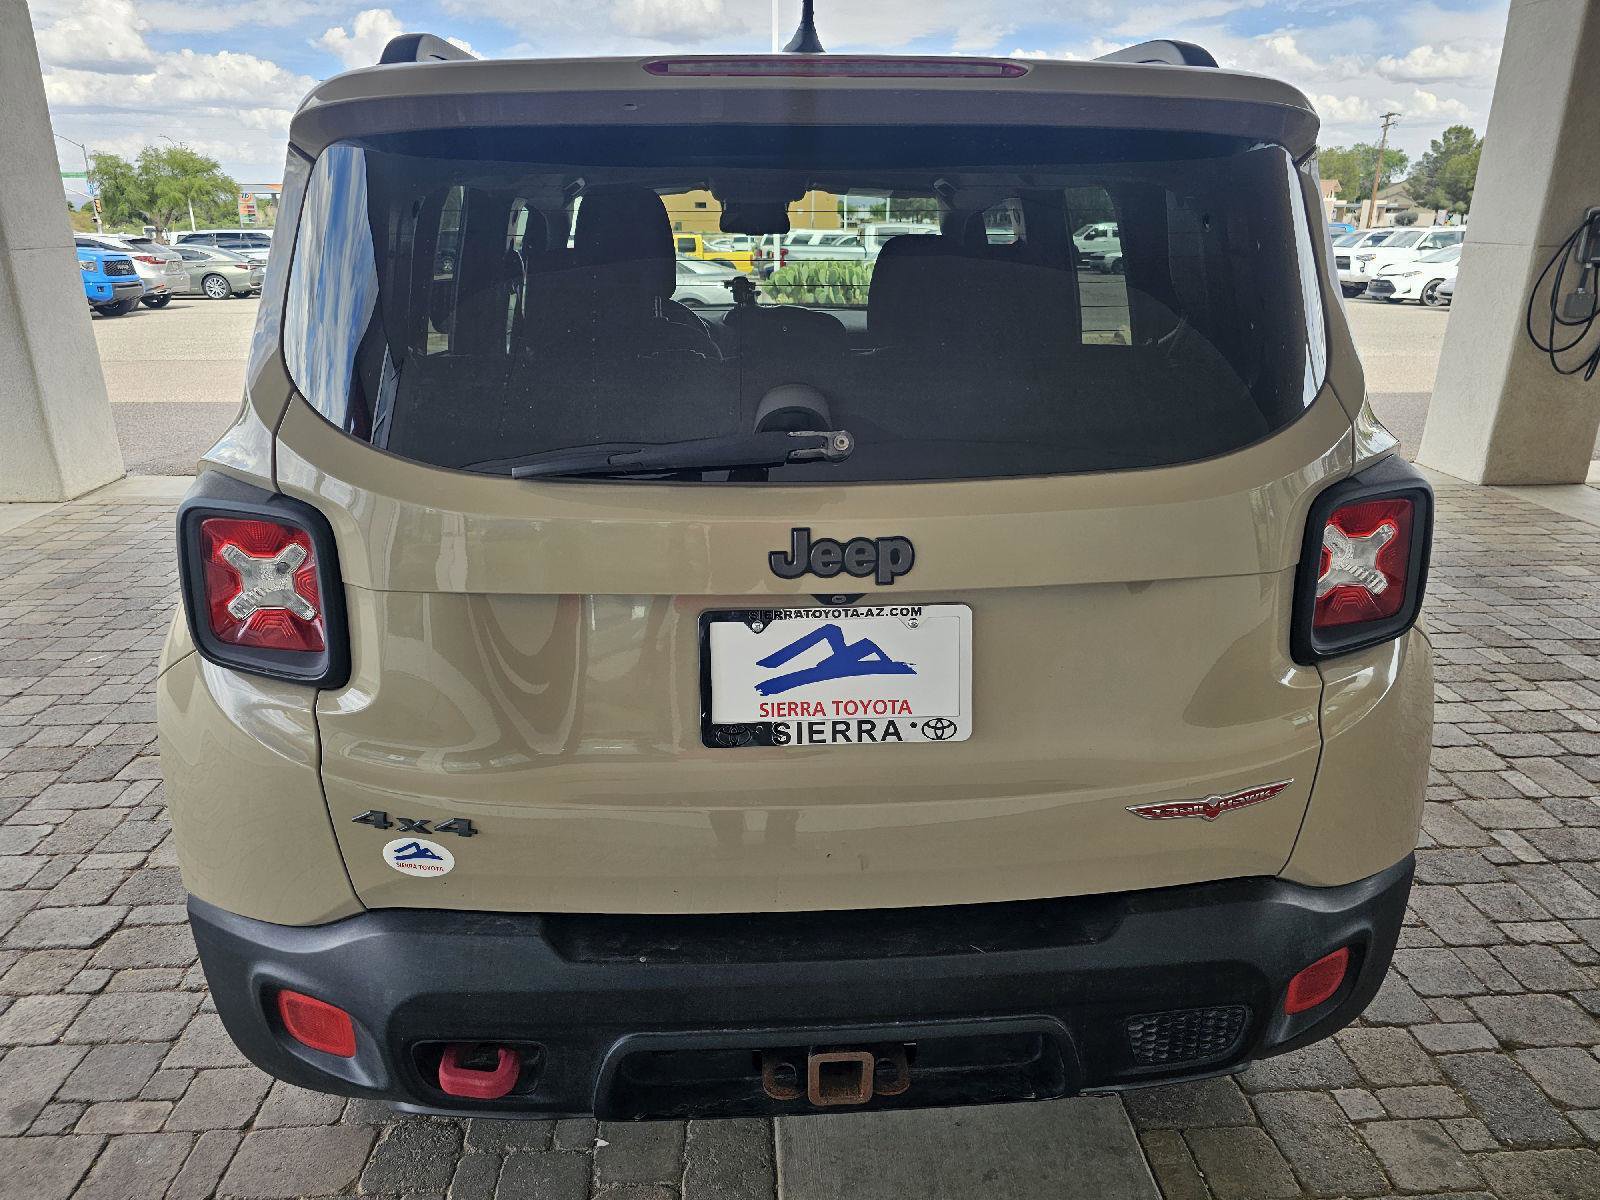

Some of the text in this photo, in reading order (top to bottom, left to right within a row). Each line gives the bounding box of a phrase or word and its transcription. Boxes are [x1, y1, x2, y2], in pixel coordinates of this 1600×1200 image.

[768, 527, 916, 586] Jeep
[748, 606, 922, 621] SIERRATOYOTA-AZ.COM
[759, 699, 913, 718] SIERRA TOYOTA
[772, 719, 904, 746] SIERRA
[418, 864, 444, 872] TOYOTA
